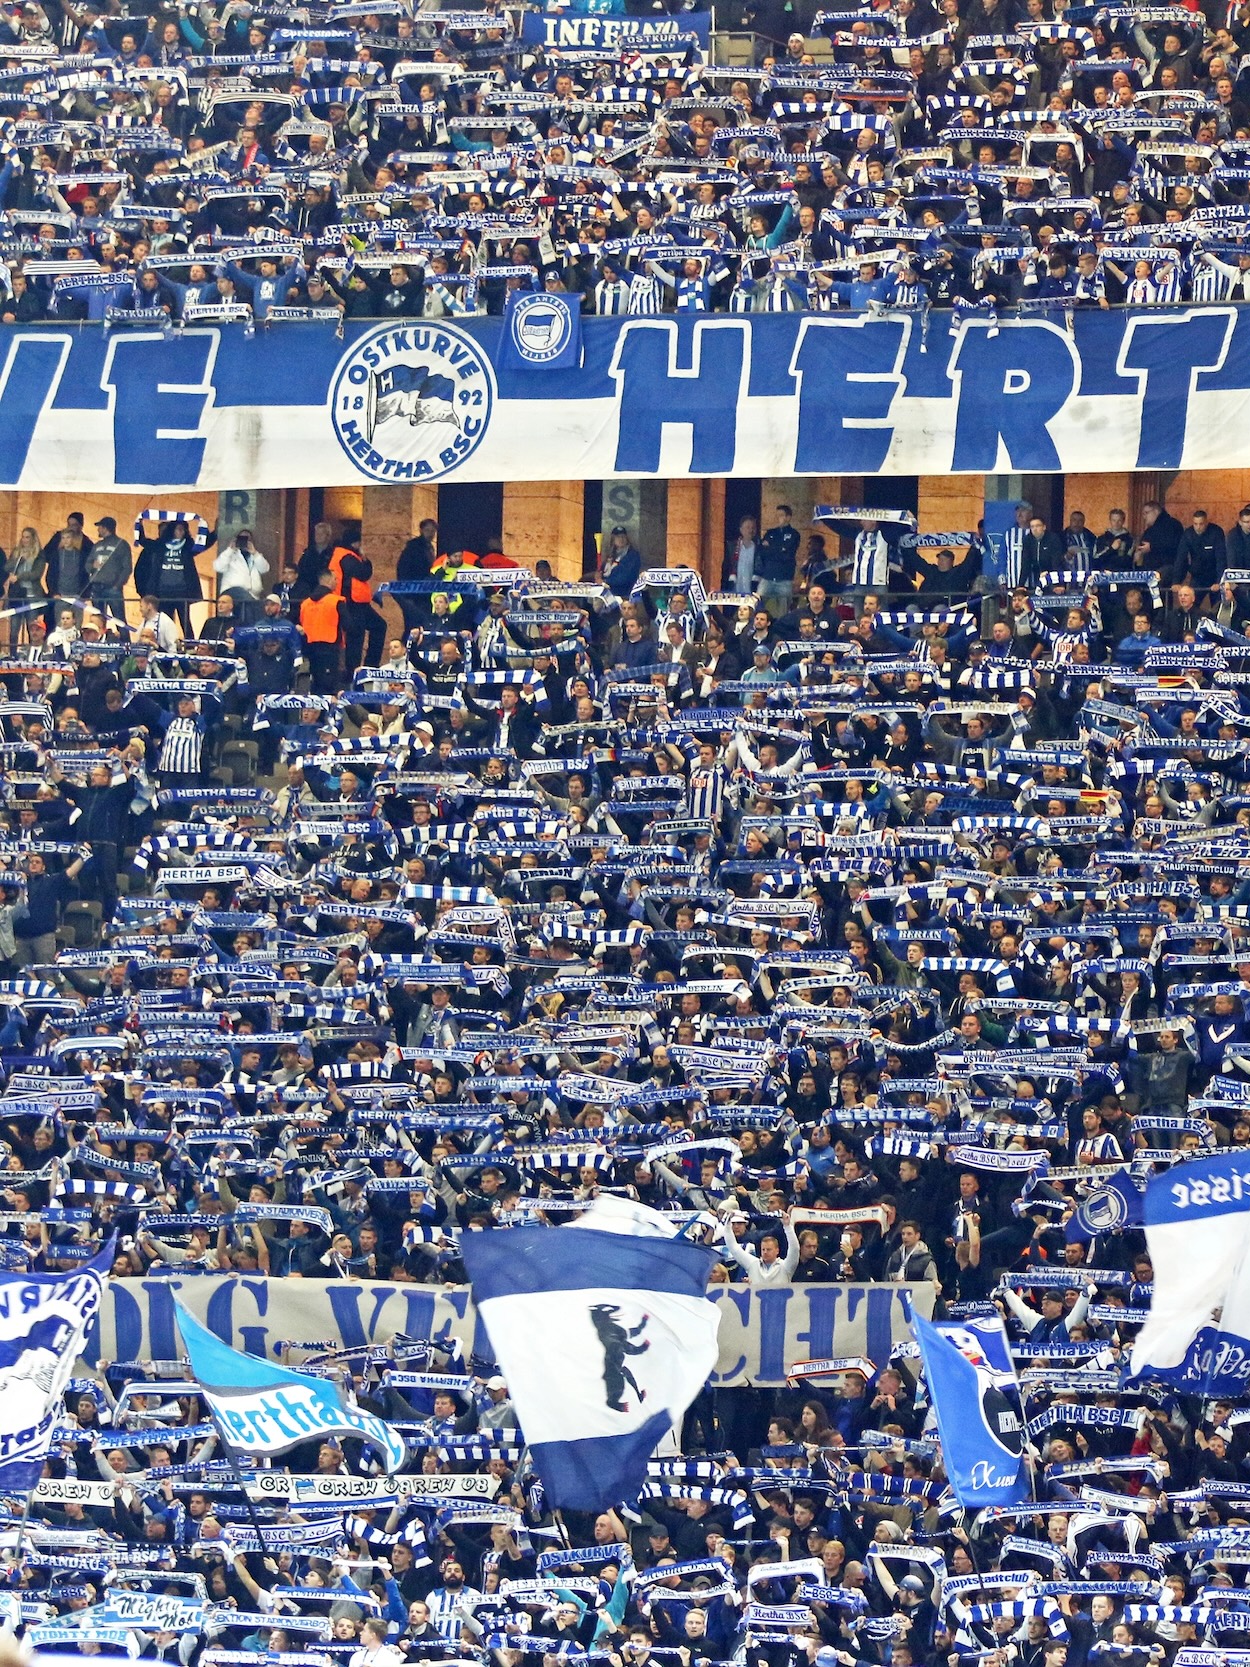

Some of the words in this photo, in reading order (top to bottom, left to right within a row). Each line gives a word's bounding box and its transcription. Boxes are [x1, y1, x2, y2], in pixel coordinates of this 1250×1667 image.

[627, 33, 693, 43] OSTKURVE
[857, 36, 896, 47] Hertha
[899, 37, 922, 47] BSC
[212, 54, 253, 64] HERTHA
[255, 52, 276, 62] BSC
[571, 102, 641, 114] BERLIN
[1108, 120, 1181, 129] OSTKURVE
[604, 234, 670, 250] OSTKURVE
[188, 306, 228, 316] HERTHA
[229, 305, 247, 314] BSC
[347, 329, 481, 387] OSTKURVE
[458, 389, 482, 406] 92
[340, 418, 435, 479] HERTHA
[439, 415, 482, 468] BSC
[224, 490, 251, 525] R
[607, 485, 635, 523] S
[134, 680, 180, 691] HERTHA
[182, 681, 207, 691] BSC
[1145, 738, 1197, 747] HERTHA
[1200, 739, 1227, 748] BSC
[527, 760, 564, 773] Hertha
[567, 758, 590, 770] BSC
[177, 789, 227, 798] HERTHA
[229, 788, 257, 797] BSC
[163, 869, 212, 879] HERTHA
[217, 867, 242, 876] BSC
[519, 868, 573, 879] BERLIN
[1163, 862, 1236, 874] HAUPTSTADTCLUB
[321, 905, 379, 917] HERTHA
[383, 909, 410, 921] BSC
[900, 930, 943, 941] BERLIN
[687, 984, 725, 992] BERLIN
[783, 974, 856, 989] BERLIN
[990, 999, 1025, 1009] Hertha
[1027, 1000, 1049, 1010] BSC
[140, 1012, 180, 1023] DANKE
[182, 1012, 221, 1023] PAPA
[835, 1108, 930, 1121] BERLIN
[819, 1211, 850, 1219] HERTHA
[851, 1209, 868, 1218] BSC
[803, 1360, 831, 1372] HERTHA
[833, 1358, 849, 1368] BSC
[109, 1431, 170, 1447] HERTHA
[175, 1427, 201, 1439] BSC
[35, 1481, 91, 1499] CREW
[317, 1478, 377, 1498] CREW
[459, 1476, 490, 1494] '08
[32, 1553, 100, 1571] SPANDAU
[119, 1594, 181, 1617] Mighty
[159, 1613, 194, 1628] Mob
[752, 1608, 784, 1619] Hertha
[786, 1610, 808, 1621] BSC
[31, 1628, 87, 1642] MIGHTY
[94, 1628, 128, 1641] MOB
